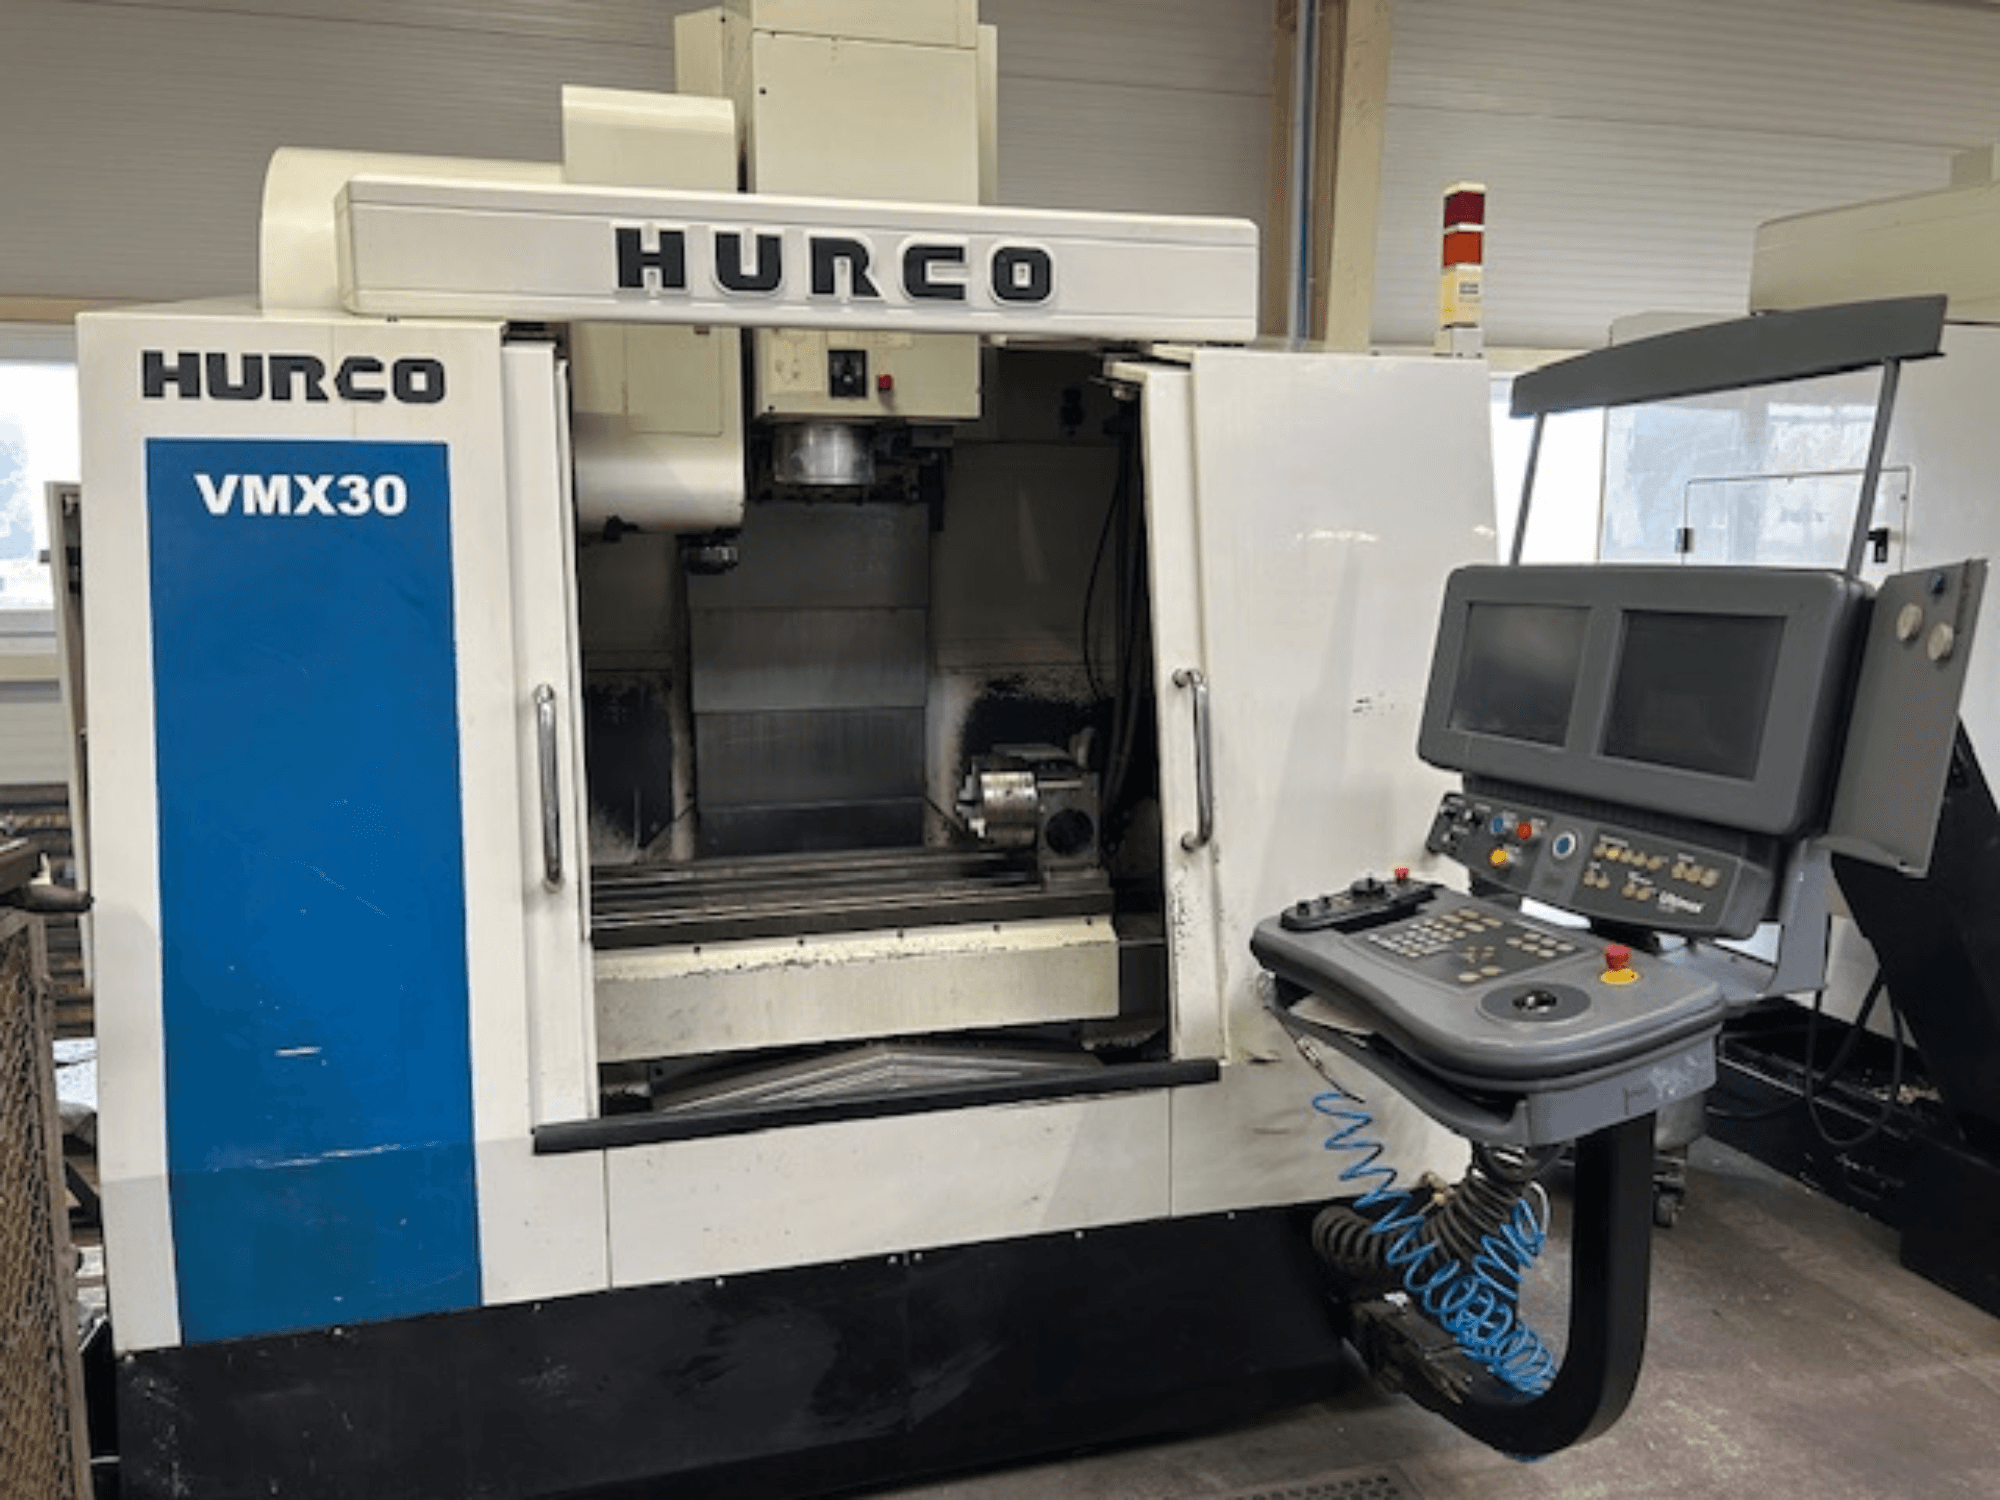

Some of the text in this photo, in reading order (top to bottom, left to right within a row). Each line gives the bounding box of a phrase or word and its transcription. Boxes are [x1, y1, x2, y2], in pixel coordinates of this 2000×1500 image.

[615, 227, 1052, 303] HURCO
[142, 350, 446, 403] HURCO
[194, 473, 407, 516] VMX30
